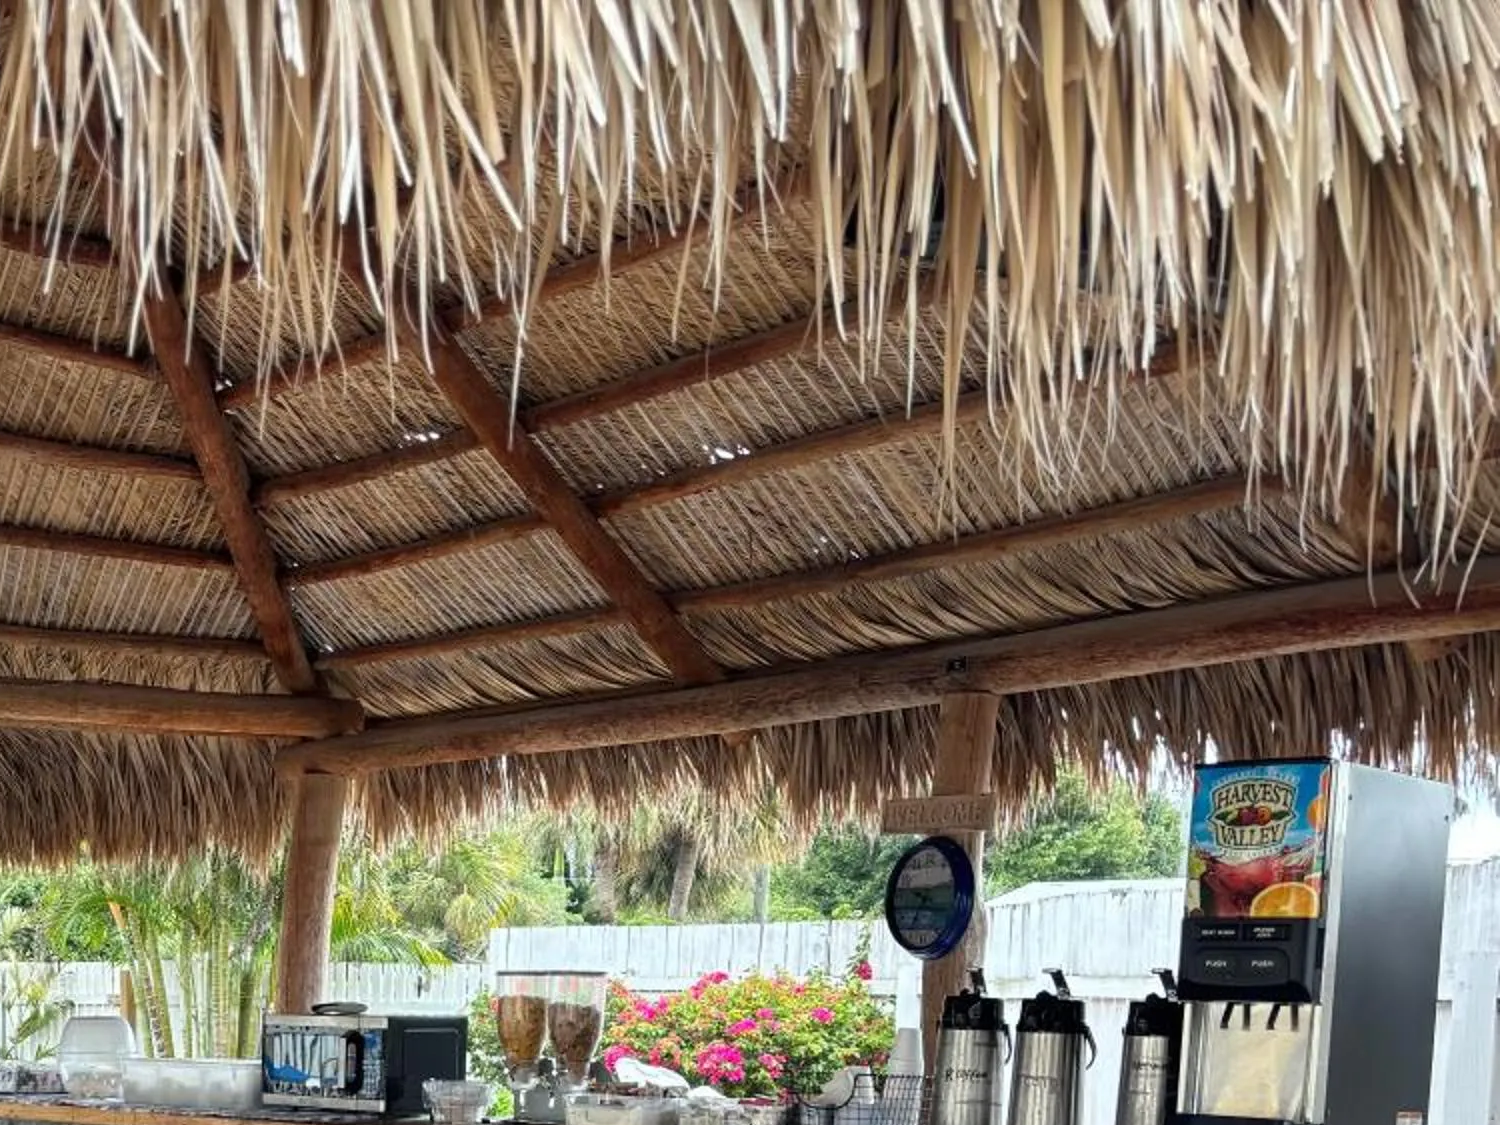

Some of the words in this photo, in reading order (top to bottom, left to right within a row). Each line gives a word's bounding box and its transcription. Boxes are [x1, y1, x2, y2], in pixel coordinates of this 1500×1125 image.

[1216, 783, 1293, 809] HARVEST
[892, 801, 983, 826] WELCOME
[1220, 823, 1281, 846] VALLEY
